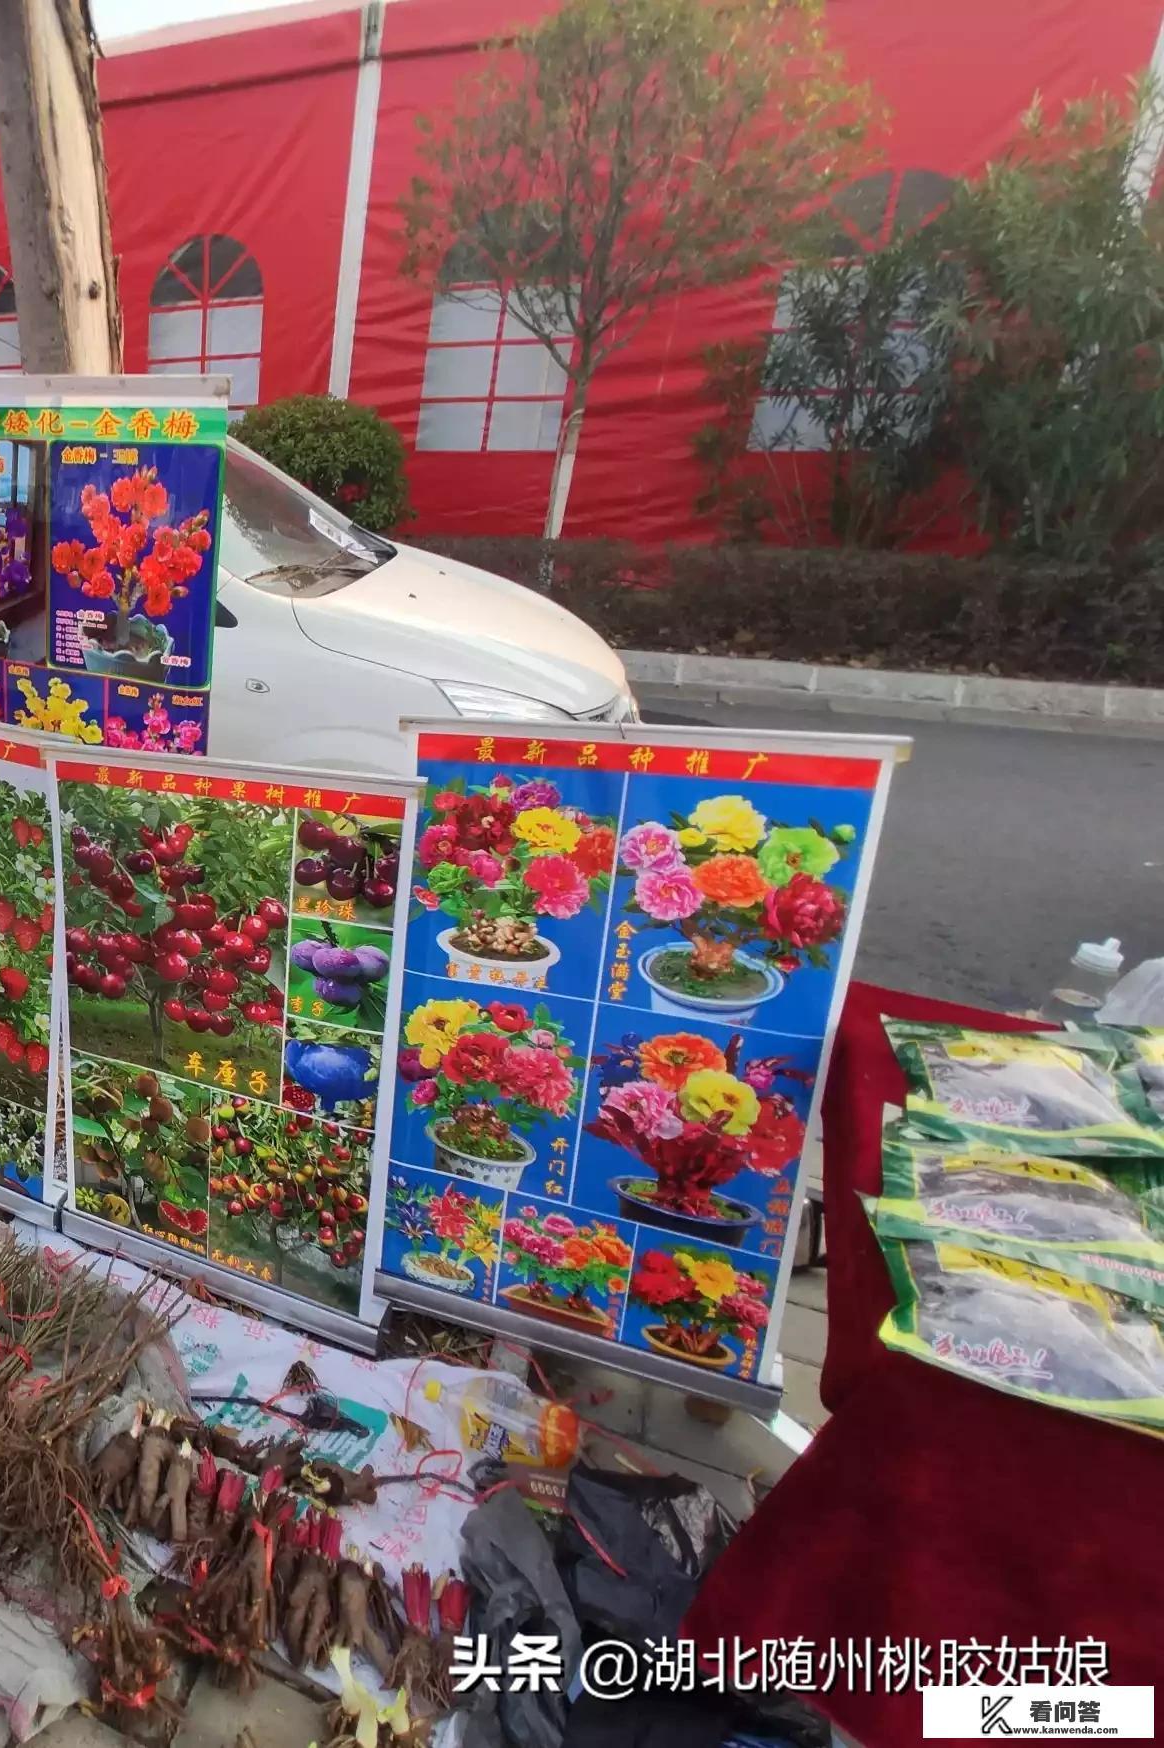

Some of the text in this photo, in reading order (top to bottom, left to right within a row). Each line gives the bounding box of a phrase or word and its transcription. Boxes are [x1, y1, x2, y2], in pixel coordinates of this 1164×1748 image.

[474, 736, 769, 780] 最新品种推广
[94, 766, 362, 812] 最新品种果树推广
[295, 897, 357, 921] 黑珍珠
[607, 920, 638, 1000] 金玉满堂
[184, 1051, 269, 1096] 车厘子
[543, 1136, 570, 1197] 开门红
